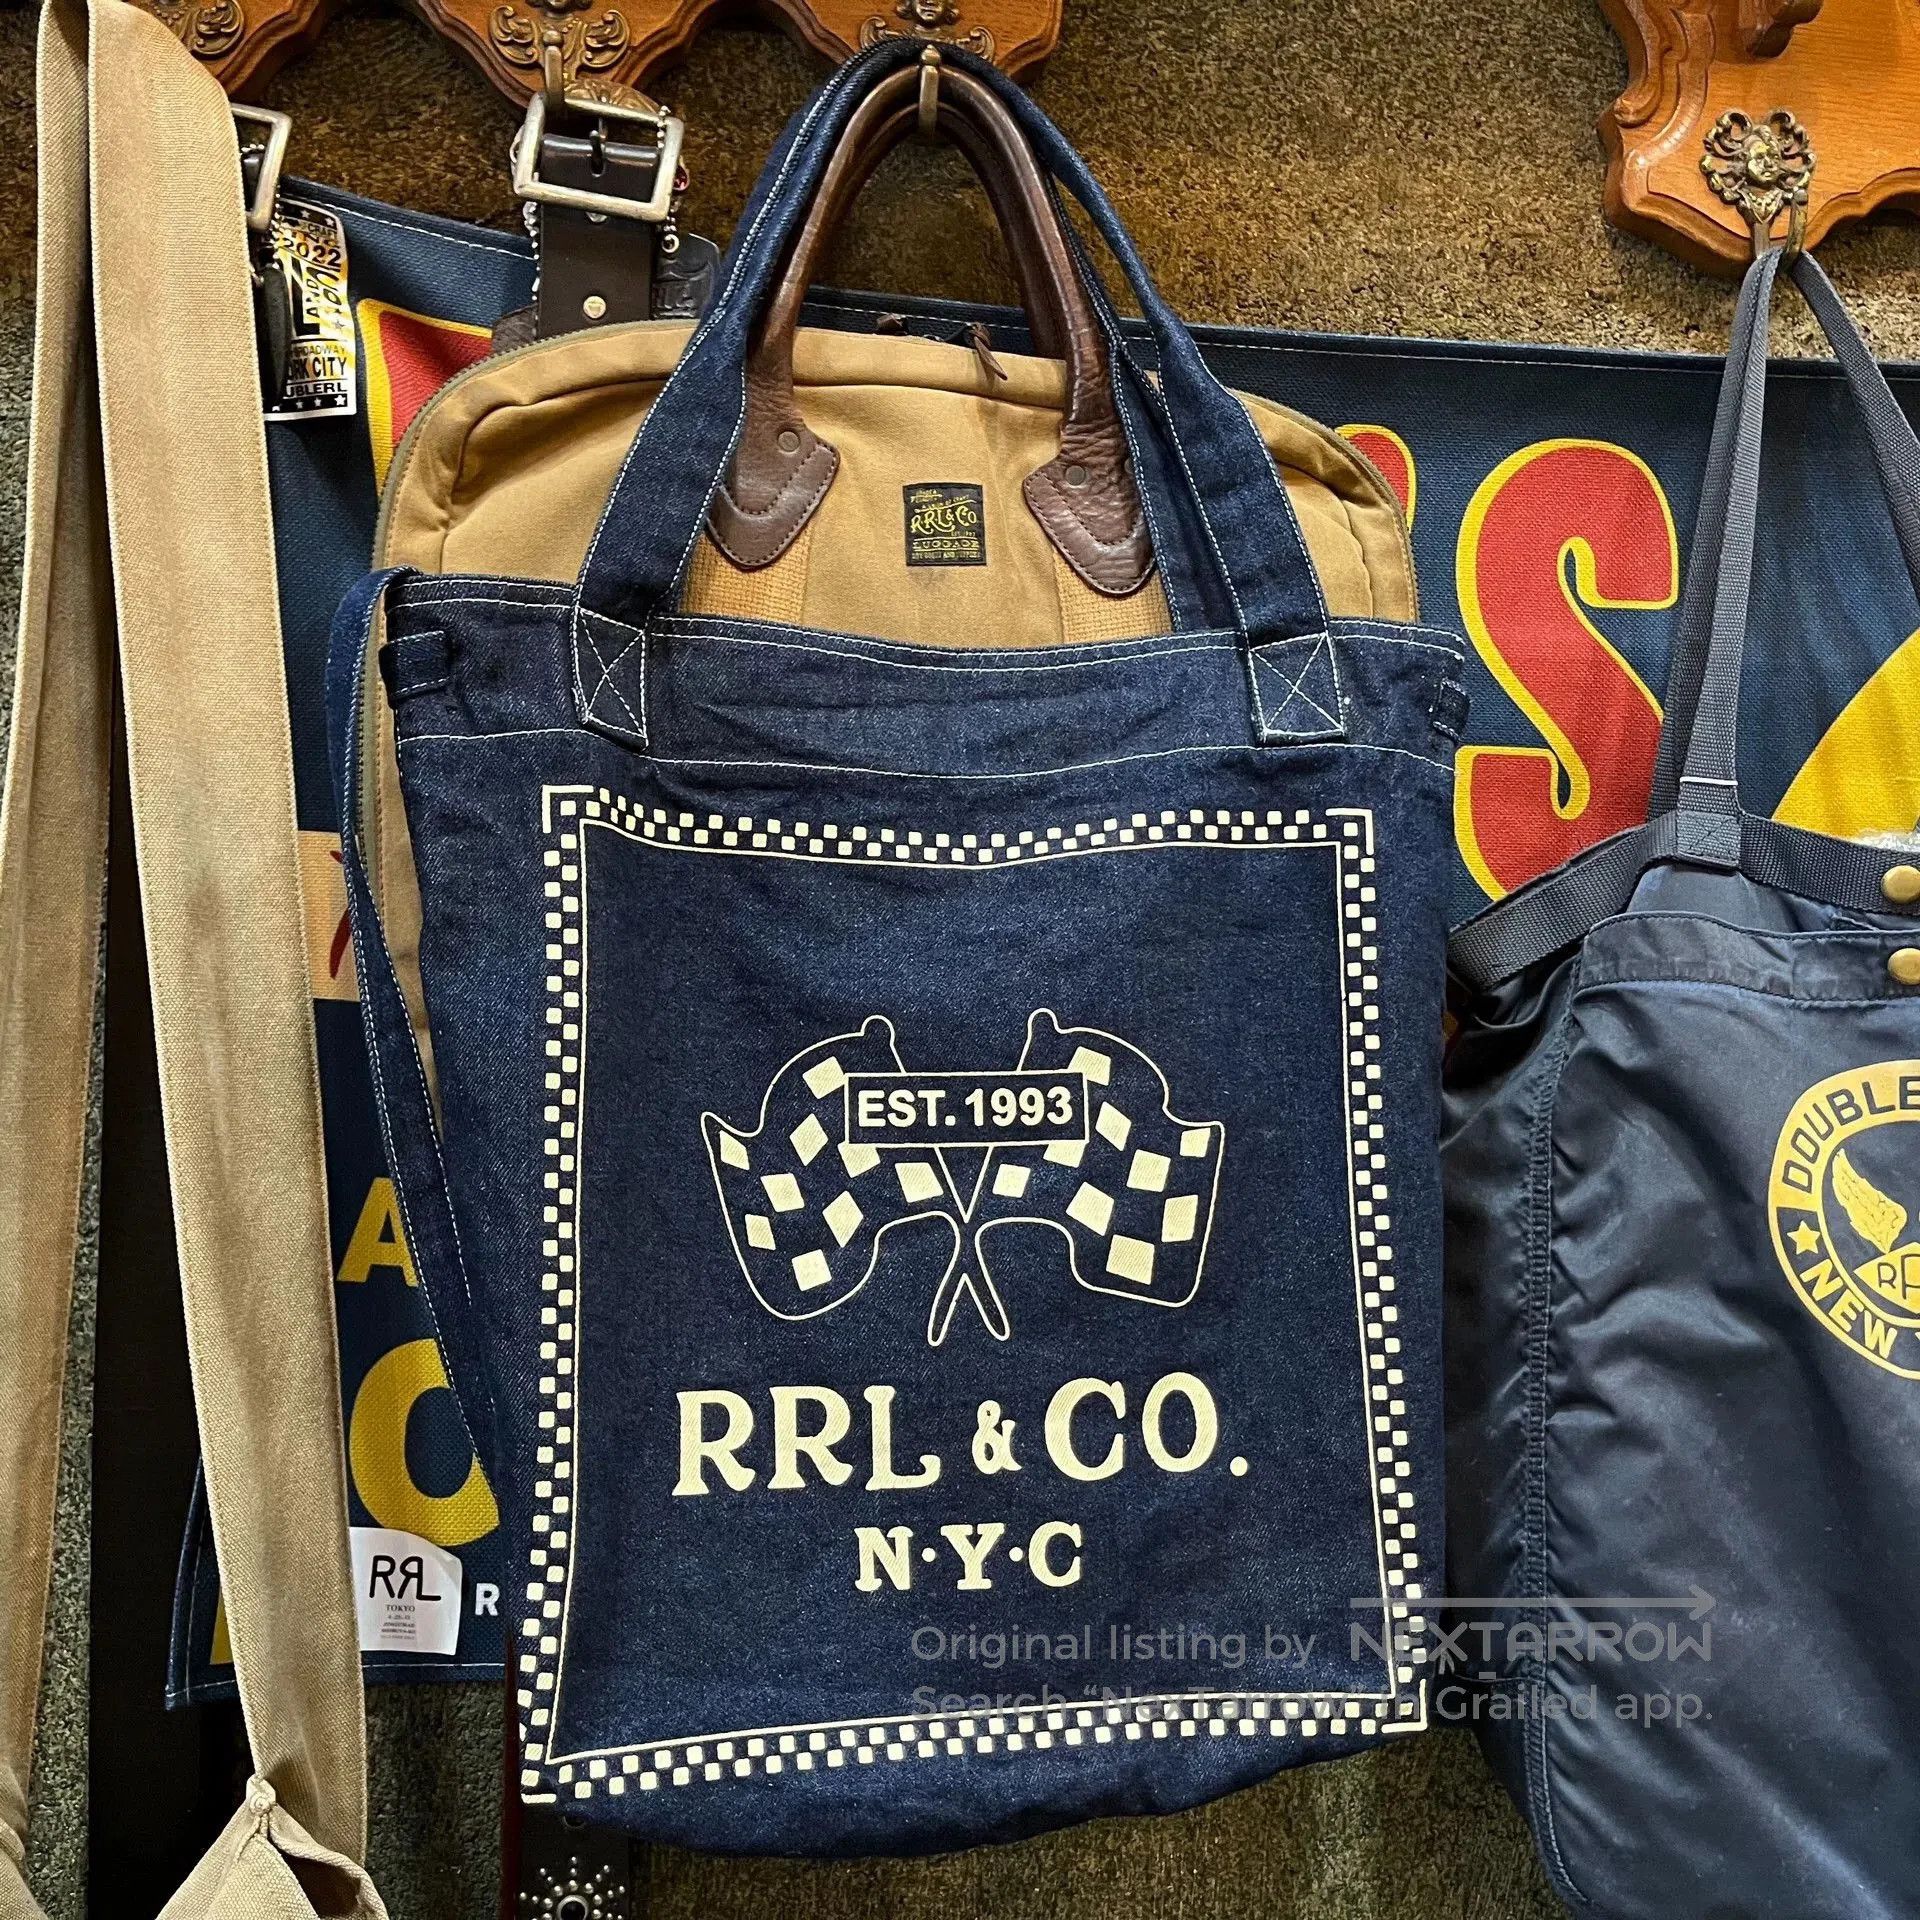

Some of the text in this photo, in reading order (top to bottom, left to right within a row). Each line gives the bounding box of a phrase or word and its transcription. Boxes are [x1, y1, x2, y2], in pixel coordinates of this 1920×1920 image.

[312, 357, 347, 379] CITY
[857, 1086, 1073, 1128] EST. 1993
[1799, 1258, 1897, 1359] NEW
[671, 1371, 1249, 1496] RRL & CO.
[385, 1604, 416, 1613] TOKYO
